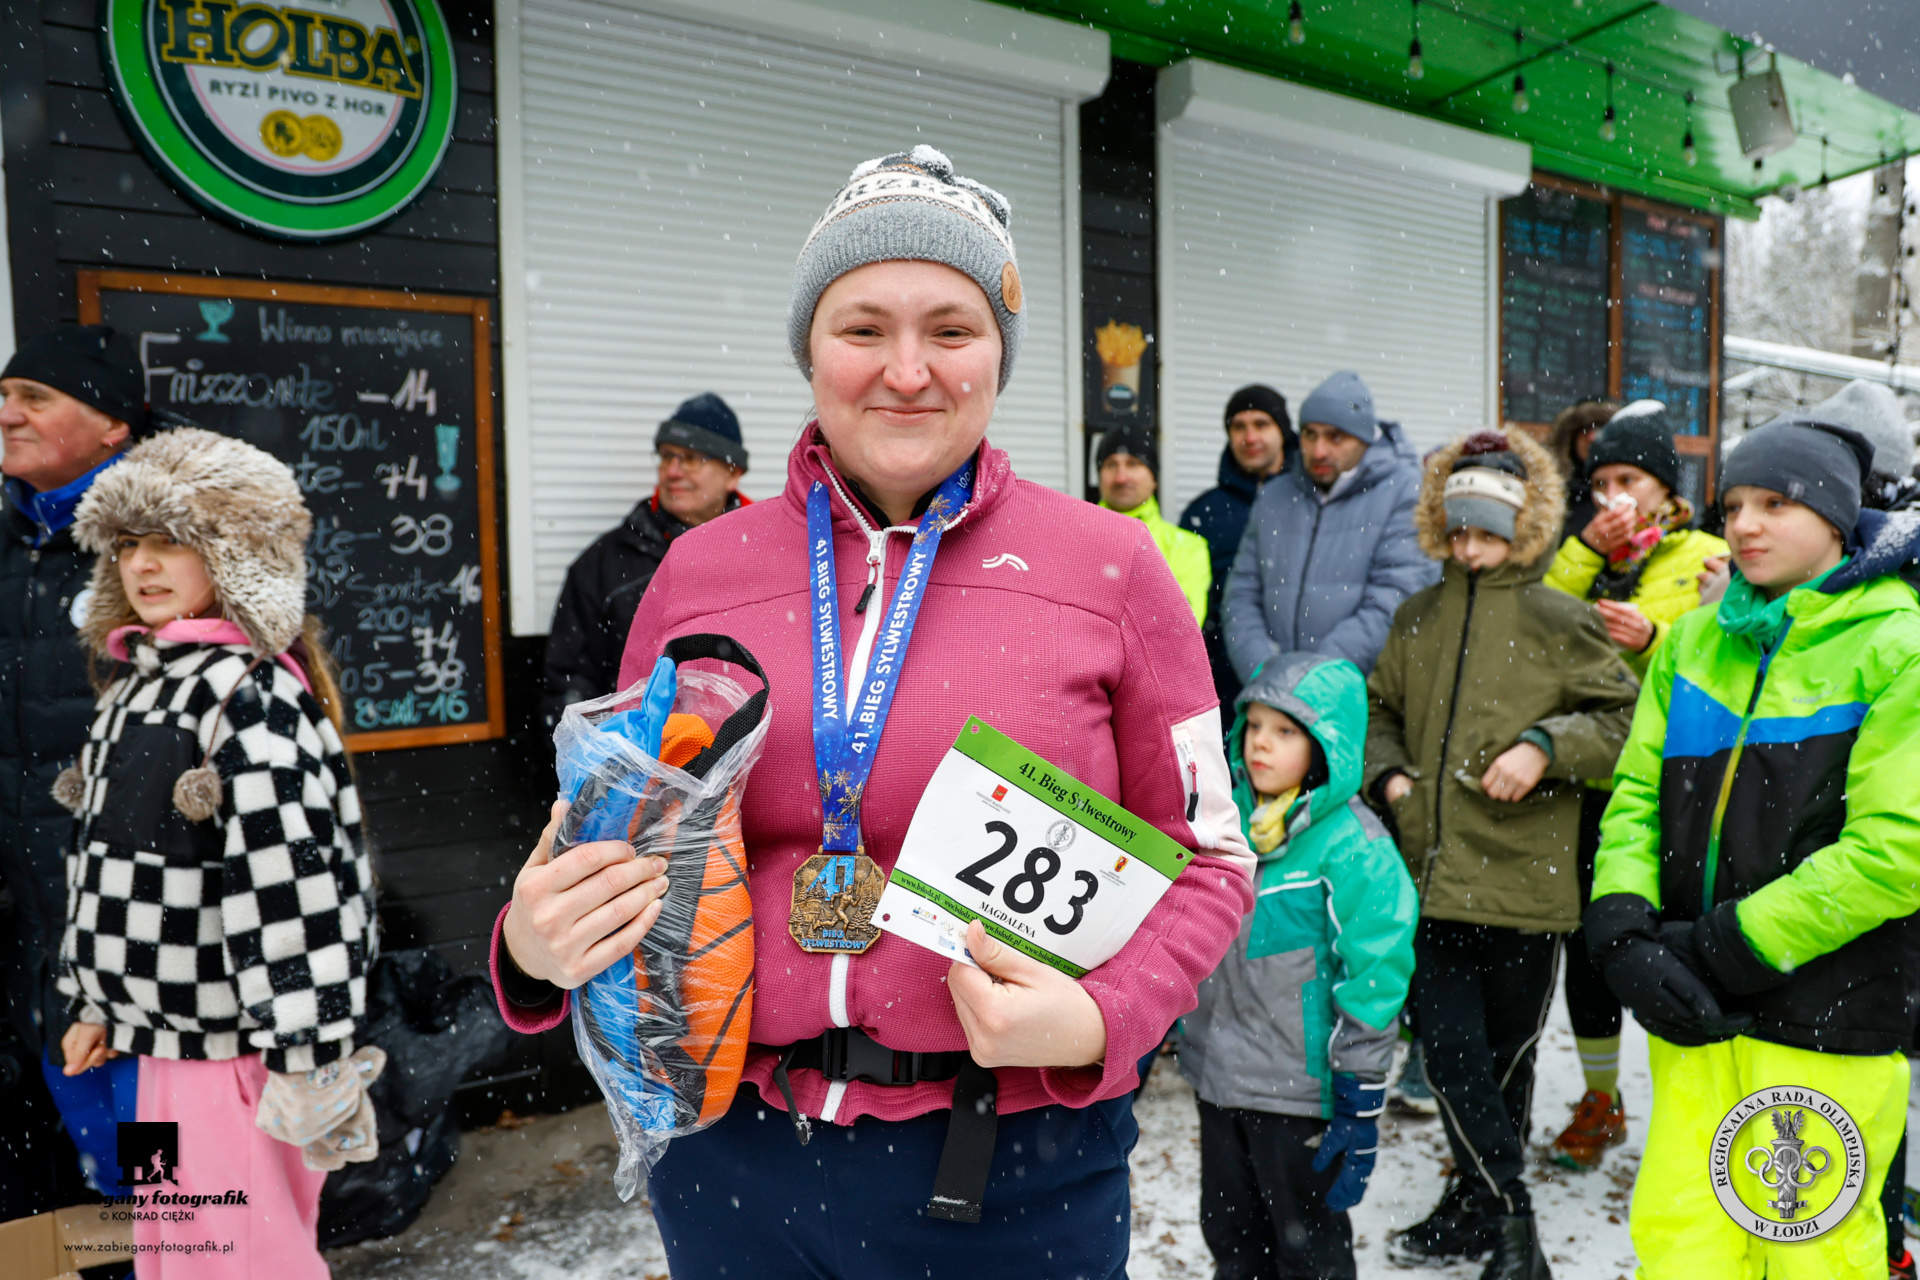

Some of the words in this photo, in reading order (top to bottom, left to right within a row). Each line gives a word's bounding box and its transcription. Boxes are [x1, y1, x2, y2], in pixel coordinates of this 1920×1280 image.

[160, 0, 422, 99] HOLBA
[208, 77, 261, 98] RYZÍ
[267, 86, 319, 107] PIVO
[324, 94, 338, 109] Z
[343, 97, 387, 117] HOR
[390, 513, 454, 556] 38
[875, 551, 927, 675] SYLWESTROWY
[818, 601, 839, 720] SYLWESTROWY
[1018, 762, 1036, 782] 41.
[1037, 773, 1068, 801] Bieg
[1067, 791, 1137, 843] Sylwestrowy
[954, 820, 1099, 935] 283
[978, 901, 1036, 939] MAGDALENA
